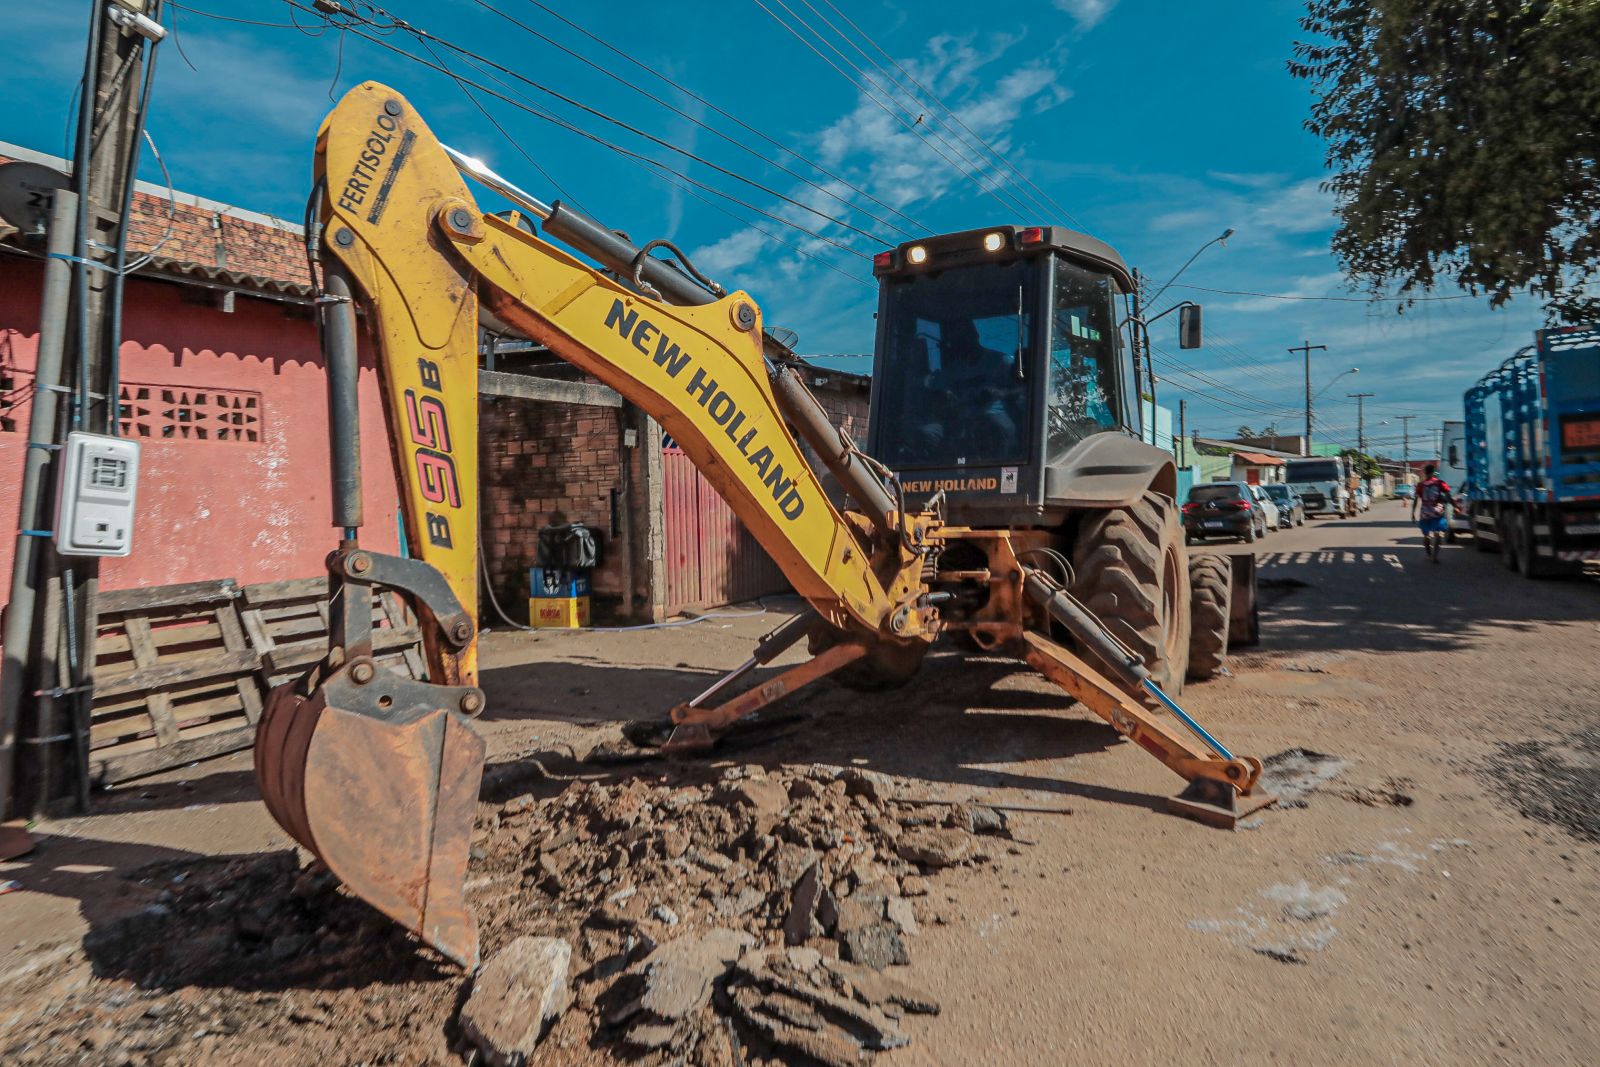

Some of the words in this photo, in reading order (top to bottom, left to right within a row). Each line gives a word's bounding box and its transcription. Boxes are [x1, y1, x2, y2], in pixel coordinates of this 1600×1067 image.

[338, 114, 396, 215] FERTISOLO
[604, 298, 692, 378] NEW
[685, 367, 805, 521] HOLLAND
[902, 481, 932, 493] NEW
[934, 478, 997, 492] HOLLAND
